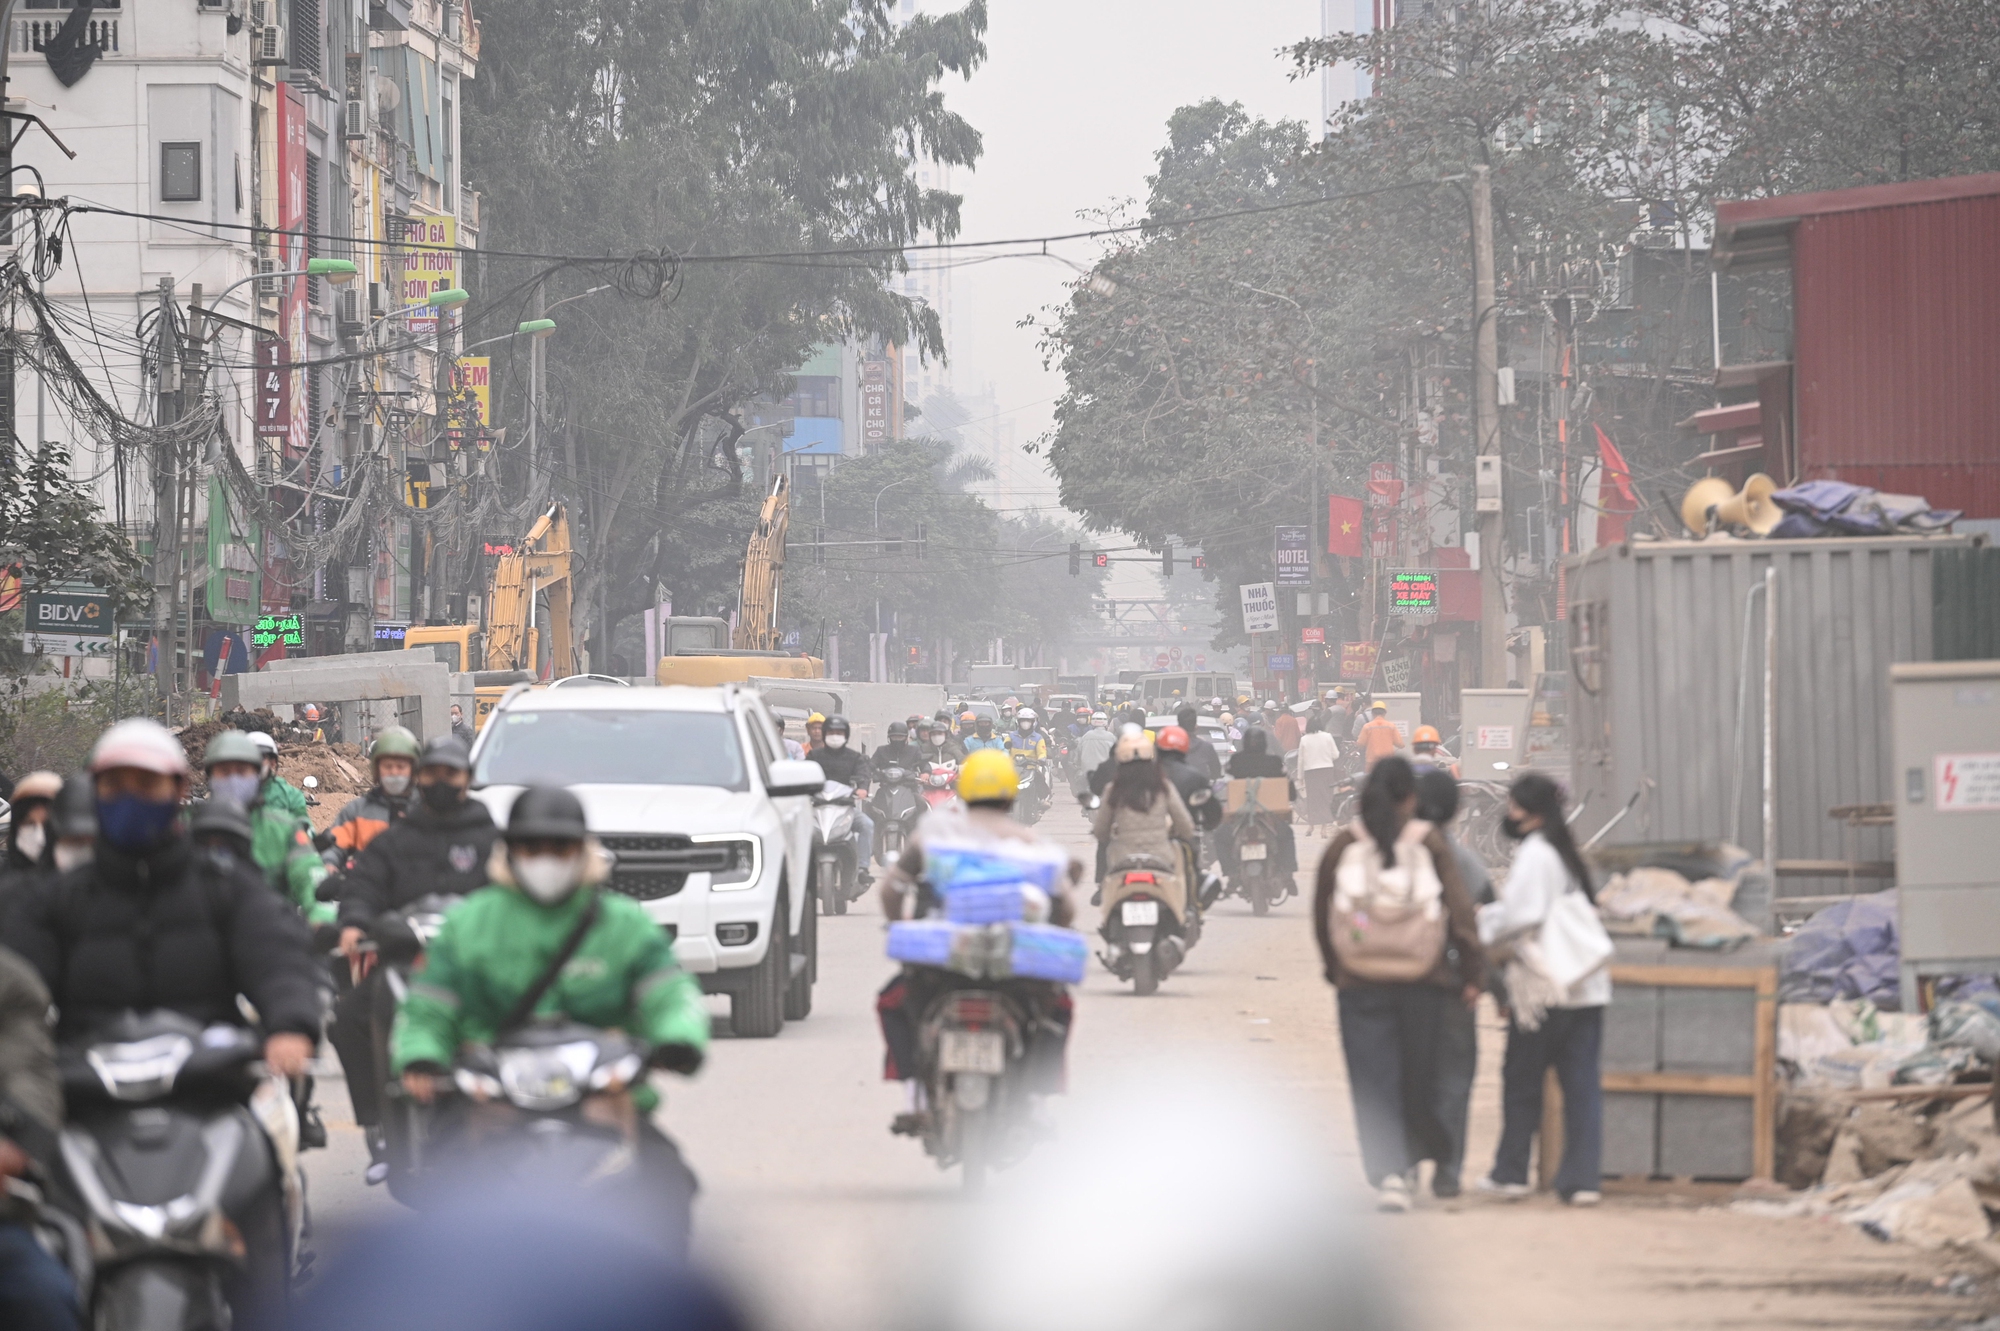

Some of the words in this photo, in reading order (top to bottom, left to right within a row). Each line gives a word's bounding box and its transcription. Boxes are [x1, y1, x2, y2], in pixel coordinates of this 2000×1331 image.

[429, 220, 446, 243] GÀ
[401, 278, 427, 299] CƠM
[1097, 555, 1107, 566] 12
[1277, 549, 1310, 564] HOTEL
[1247, 585, 1268, 599] NHÀ
[1396, 591, 1409, 600] XE
[39, 603, 85, 622] BIDV
[1243, 597, 1275, 613] THUỐC
[1385, 660, 1410, 674] BÁNH
